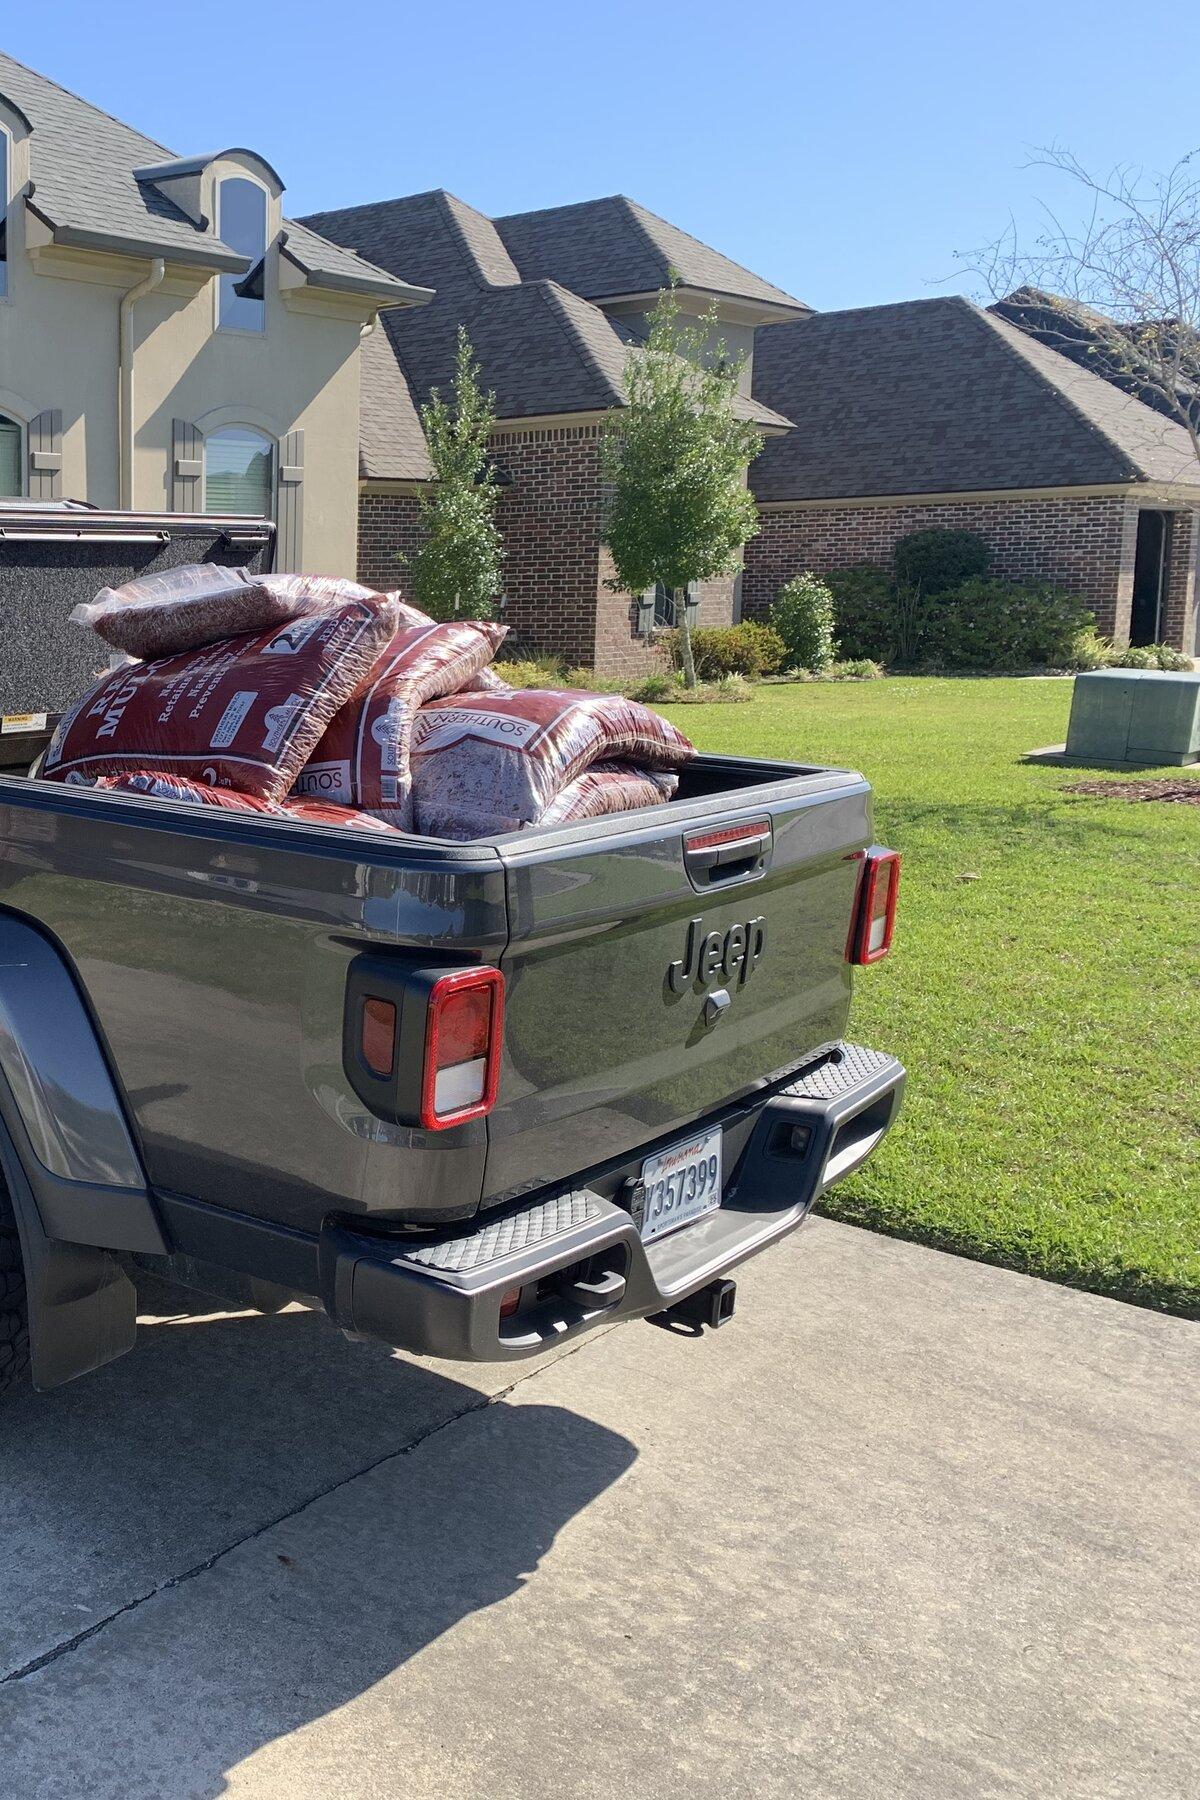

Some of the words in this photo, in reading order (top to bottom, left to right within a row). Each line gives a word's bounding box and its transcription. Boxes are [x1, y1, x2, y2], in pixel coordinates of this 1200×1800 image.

[269, 633, 309, 650] 2
[318, 618, 340, 642] RED
[321, 615, 356, 656] MULCH
[187, 652, 234, 698] Naturally
[188, 666, 231, 719] Prevents
[95, 655, 178, 739] MULC
[158, 676, 193, 723] Retains
[436, 711, 529, 737] SOUTHERN
[296, 771, 342, 793] SOUT
[668, 915, 768, 993] Jeep
